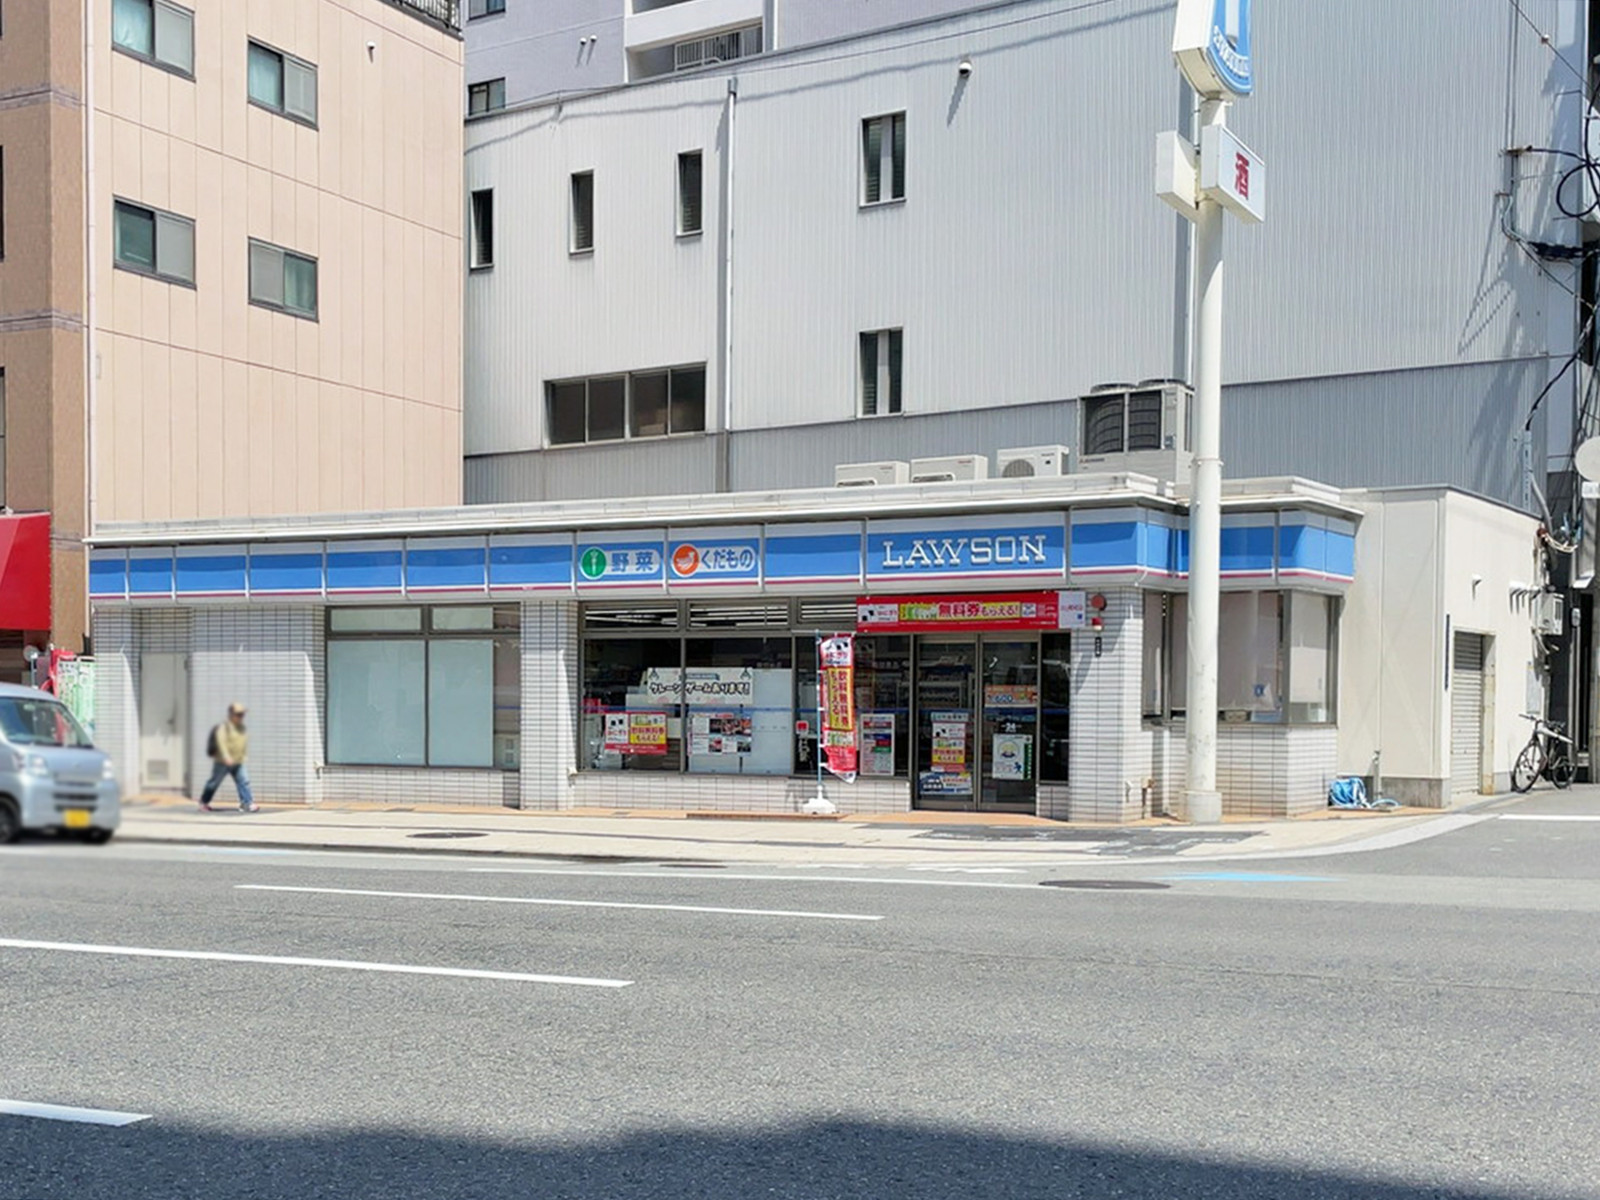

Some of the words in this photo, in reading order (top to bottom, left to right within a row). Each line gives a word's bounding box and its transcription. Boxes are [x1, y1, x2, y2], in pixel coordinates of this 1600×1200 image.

[1235, 152, 1249, 200] 酒
[611, 551, 653, 572] 野菜
[700, 548, 753, 569] くだもの
[882, 534, 1046, 568] LAWSON
